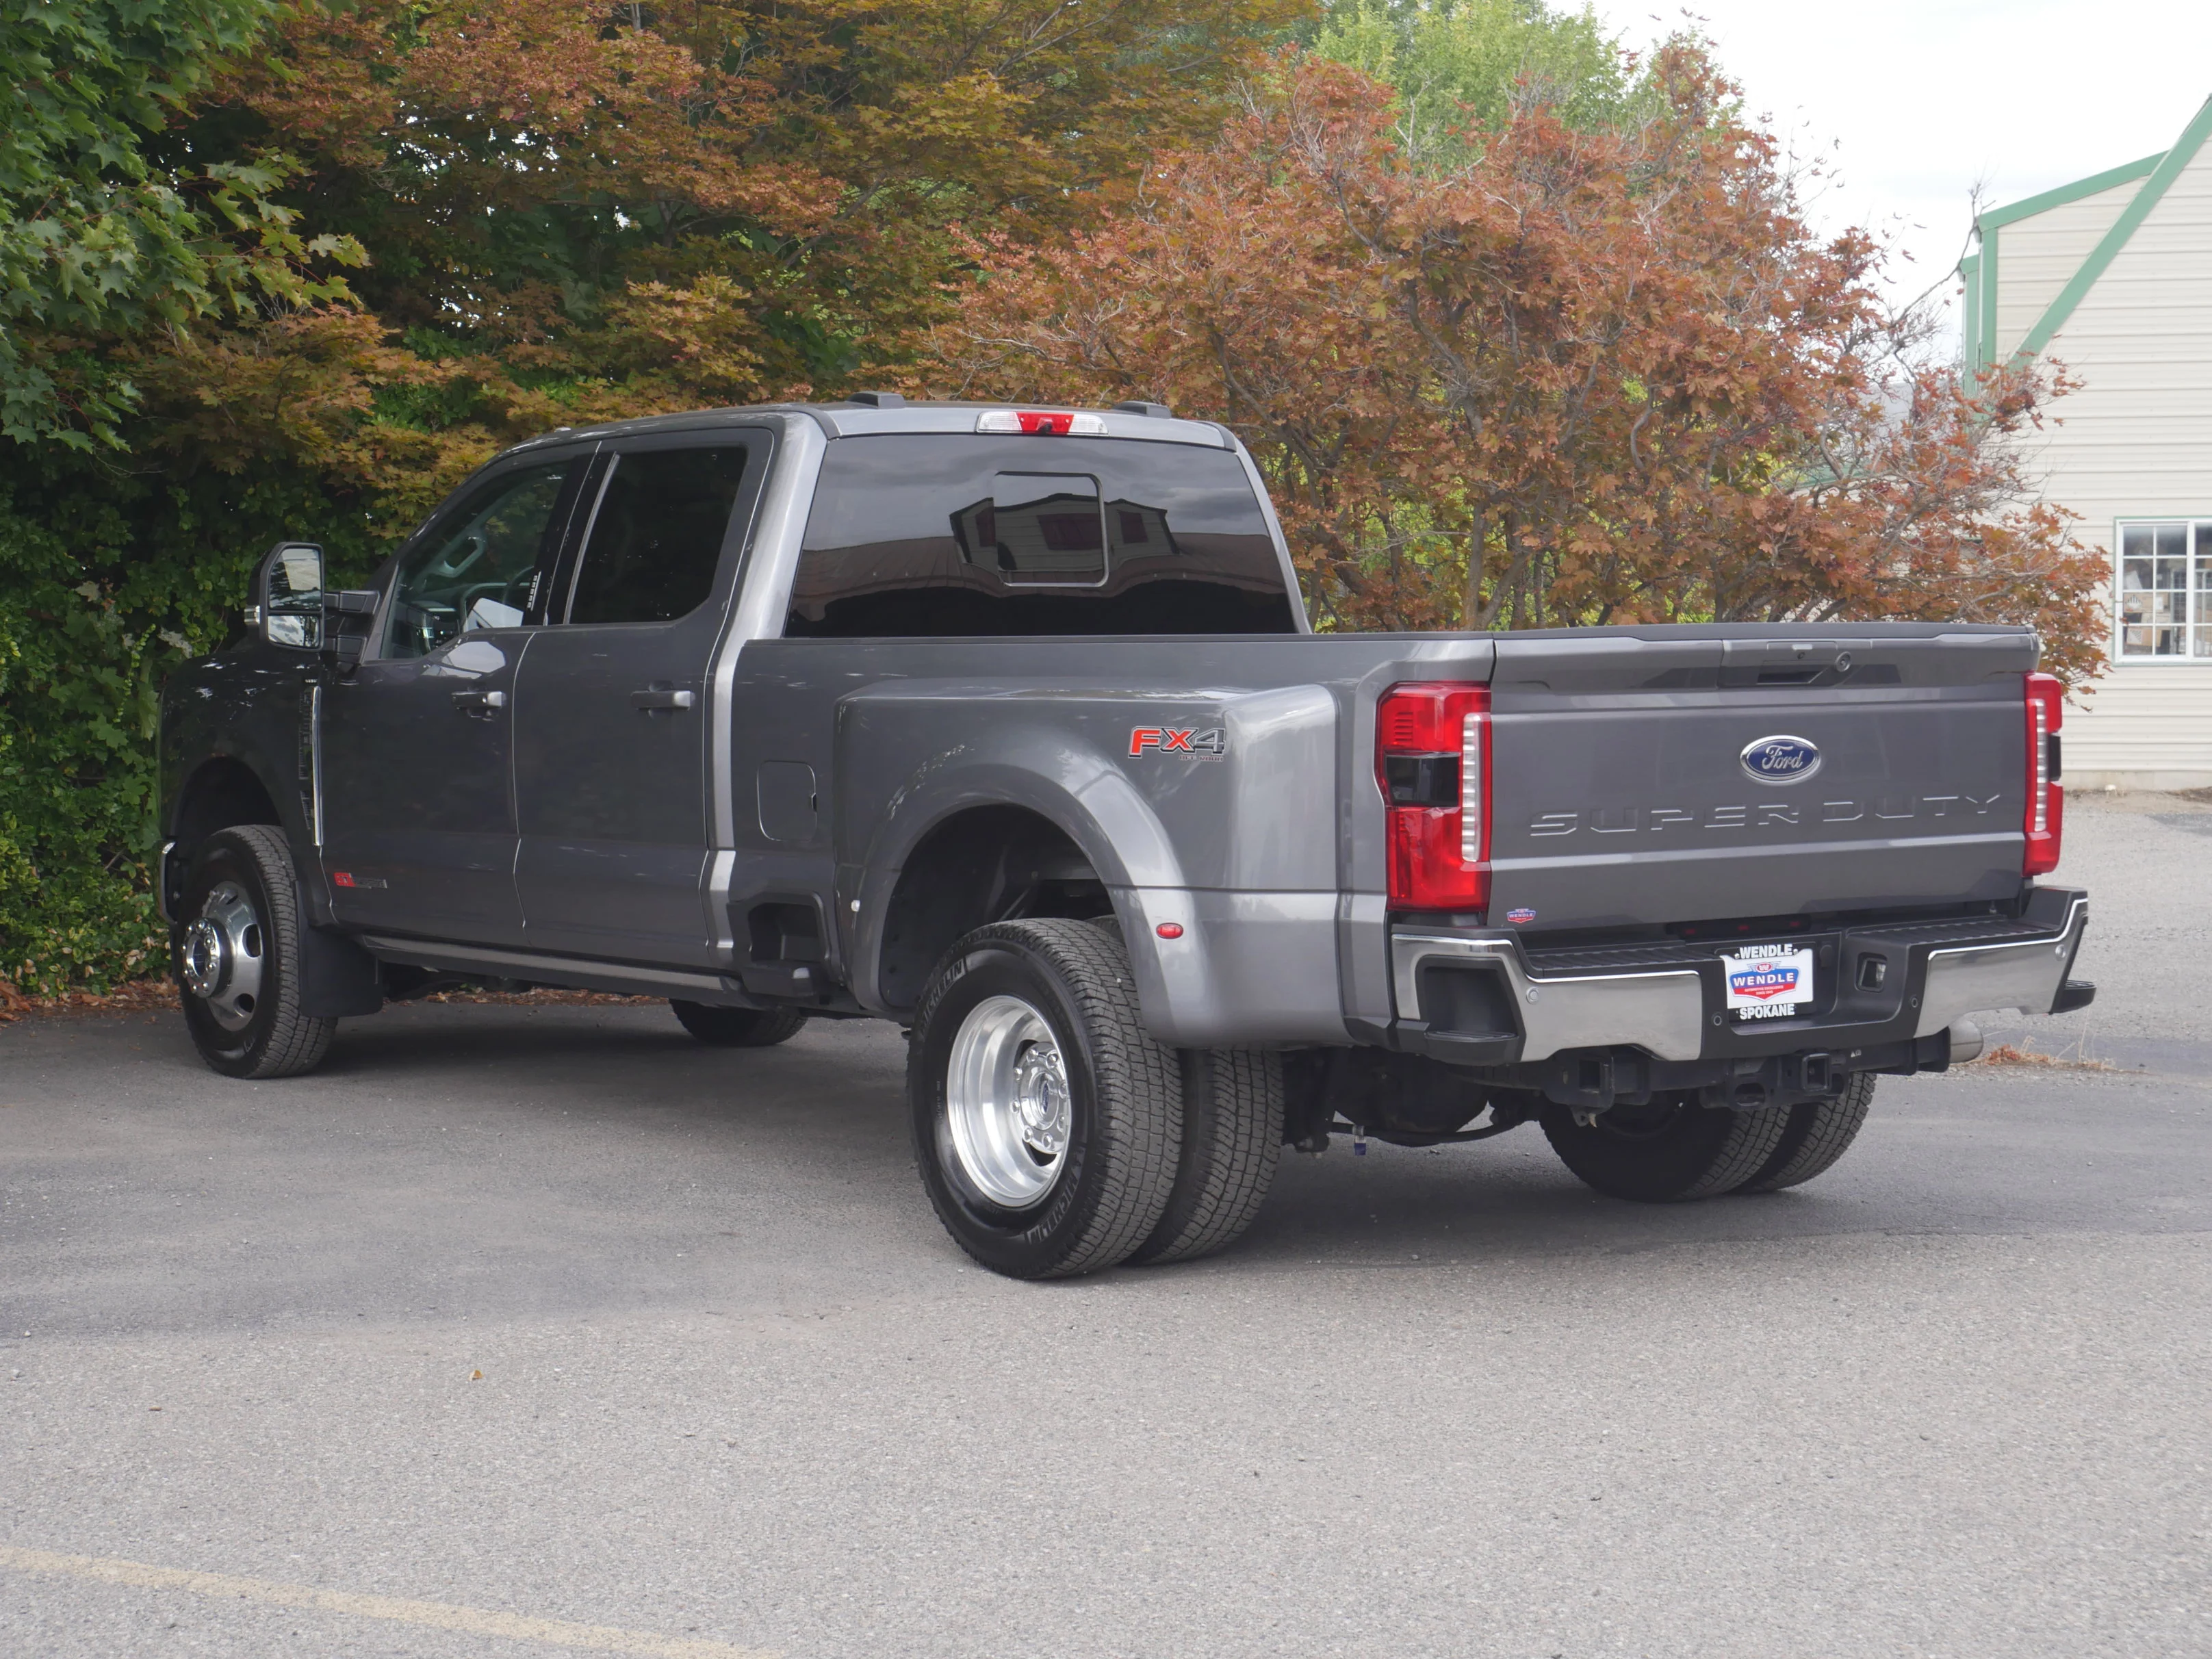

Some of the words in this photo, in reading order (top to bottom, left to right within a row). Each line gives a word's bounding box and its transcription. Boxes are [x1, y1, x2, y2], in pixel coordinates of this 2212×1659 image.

[1128, 726, 1225, 758] FX4
[1762, 745, 1804, 769] Ford
[1530, 801, 1799, 836] SUPER
[1823, 790, 2001, 823] DUTY
[1739, 944, 1793, 960] WENDLE
[1733, 973, 1795, 986] WENDLE
[1740, 1004, 1795, 1020] SPOKANE
